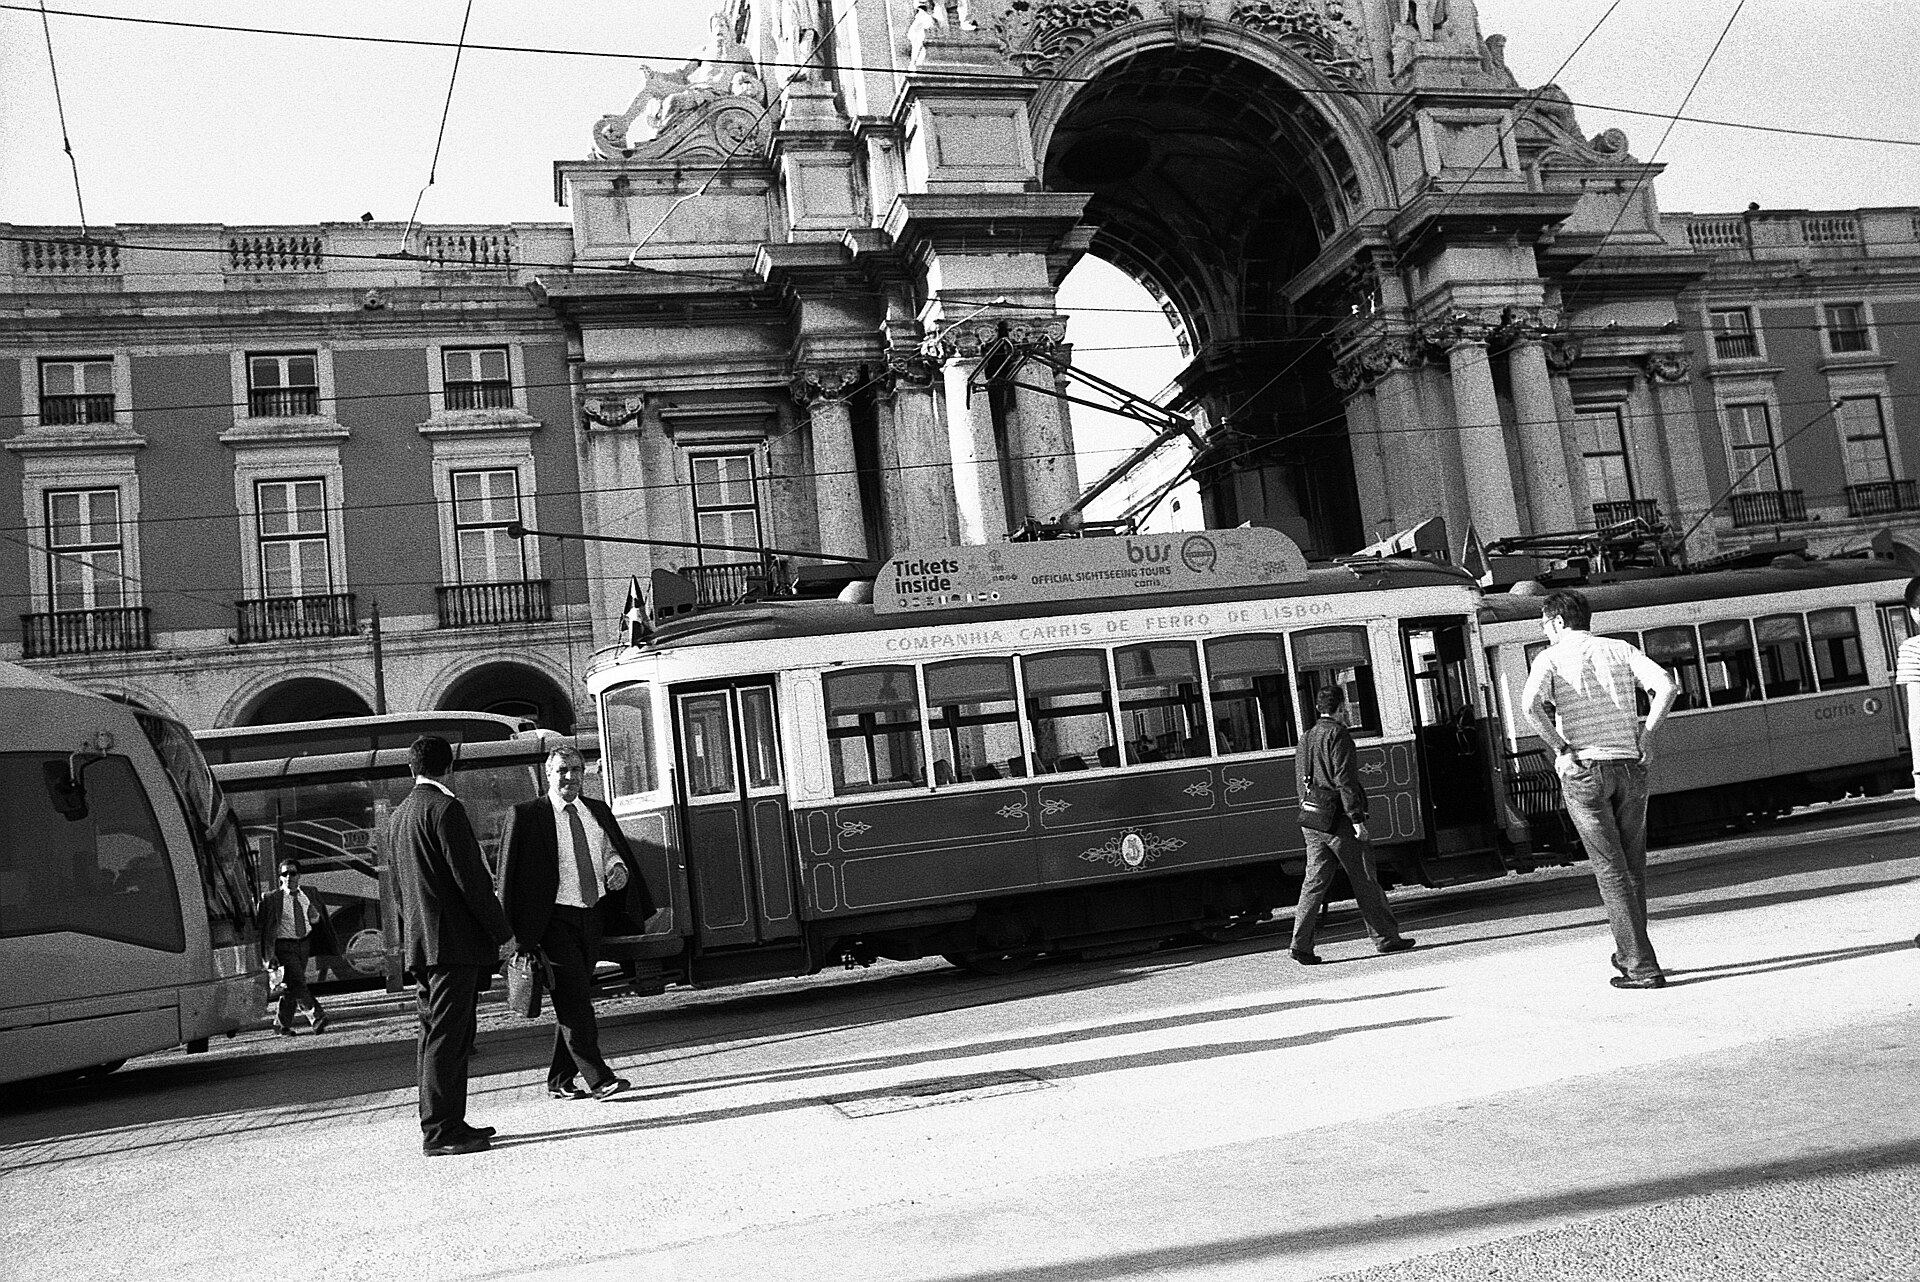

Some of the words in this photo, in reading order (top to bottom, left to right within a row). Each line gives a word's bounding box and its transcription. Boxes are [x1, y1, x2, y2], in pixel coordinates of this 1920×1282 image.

[1126, 540, 1171, 563] bus
[893, 559, 959, 576] Tickets
[1031, 573, 1074, 585] OFFICIAL
[1076, 569, 1138, 581] SIGHTSEEING
[1140, 566, 1171, 577] TOURS
[895, 576, 951, 594] inside
[886, 630, 1003, 650] COMPANHIA
[1019, 622, 1092, 641] CARRIS
[1107, 619, 1131, 633] DE
[1146, 613, 1210, 630] FERRO
[1228, 609, 1250, 623] DE
[1263, 601, 1334, 621] LISBOA
[1814, 702, 1856, 720] carris
